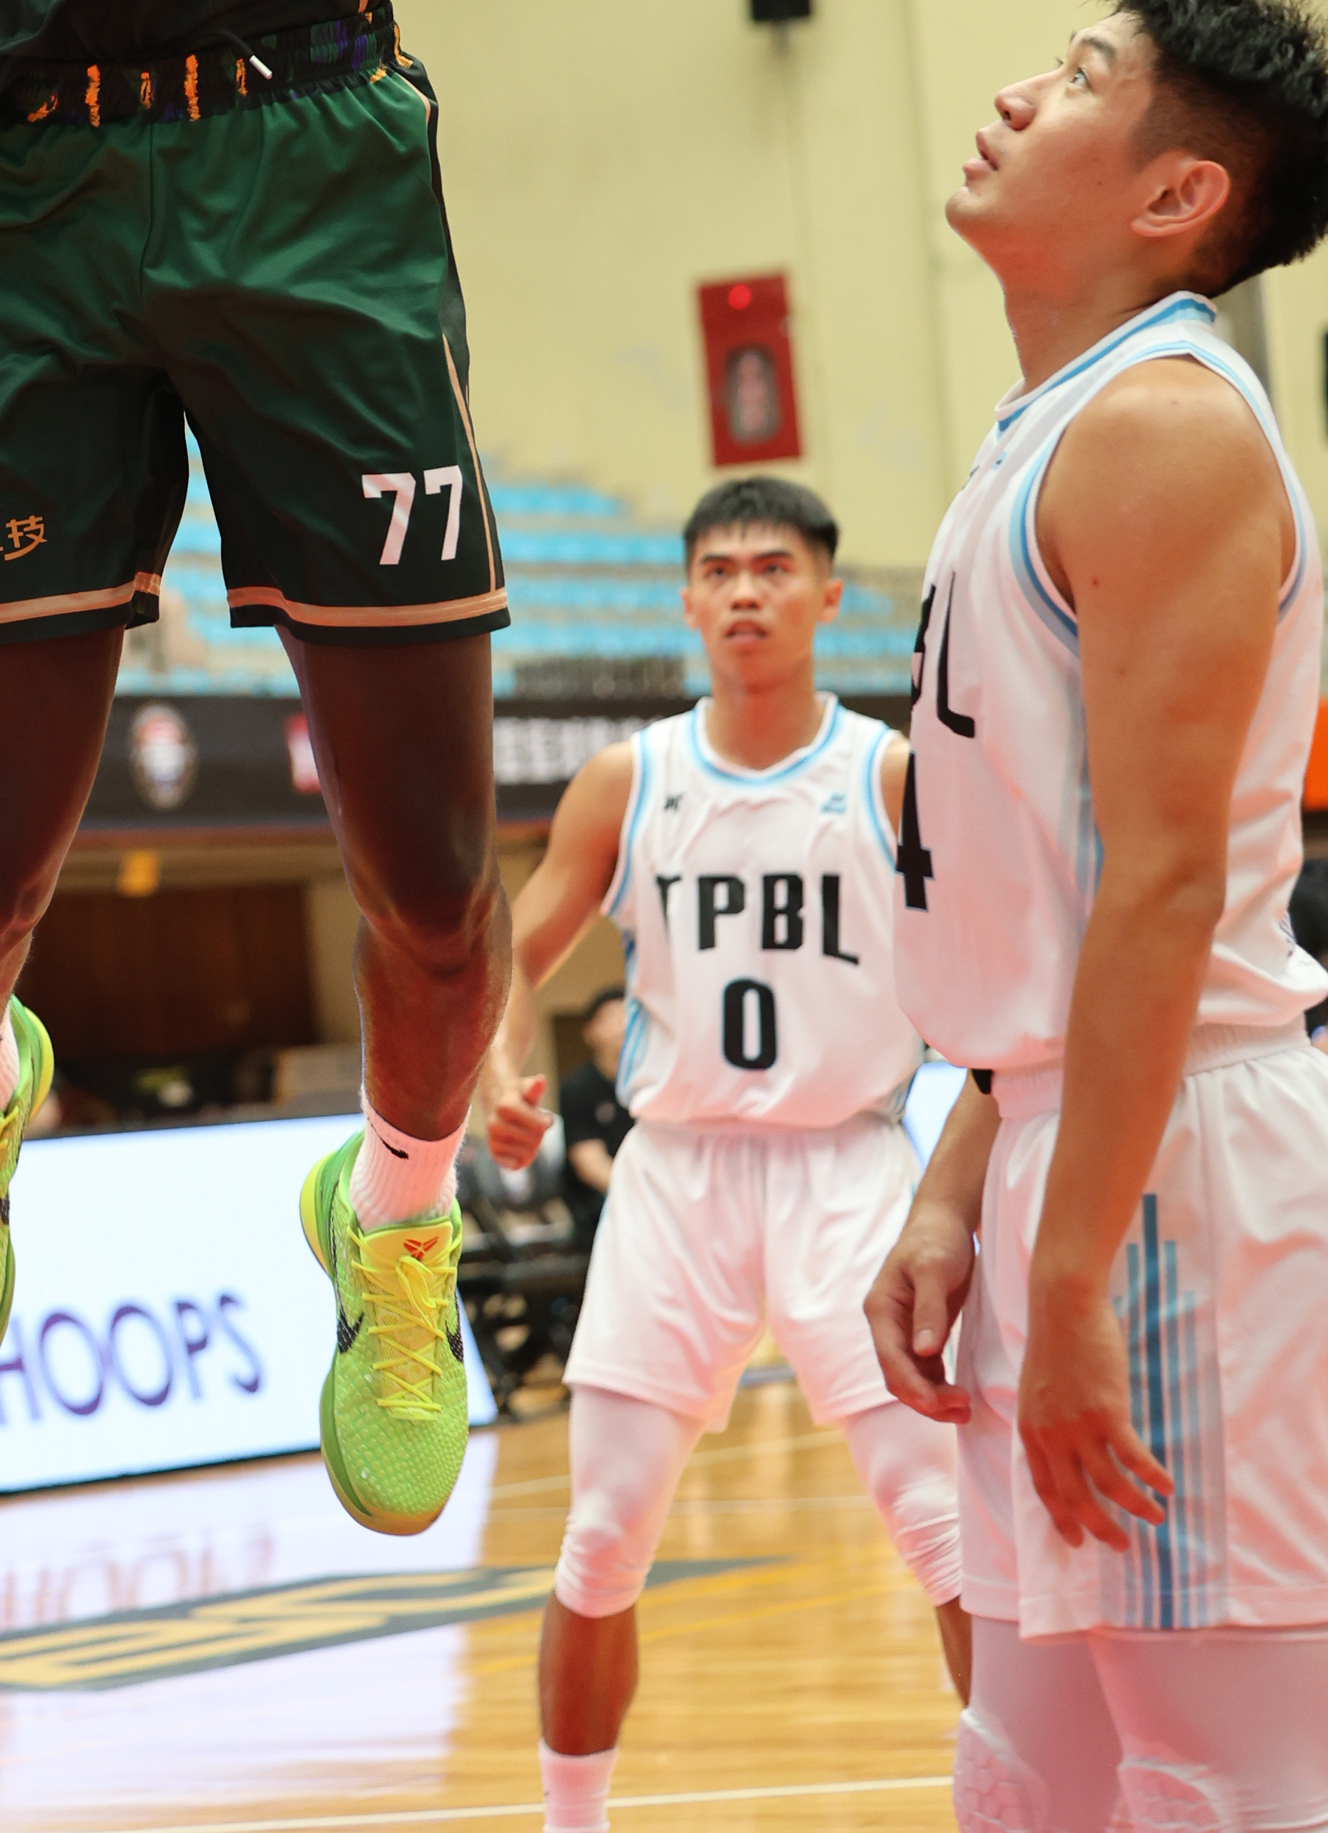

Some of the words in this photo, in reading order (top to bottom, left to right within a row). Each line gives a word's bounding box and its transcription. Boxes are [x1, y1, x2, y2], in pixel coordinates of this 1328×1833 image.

[361, 464, 463, 565] 77
[656, 872, 860, 966] TPBL
[722, 977, 777, 1071] 0
